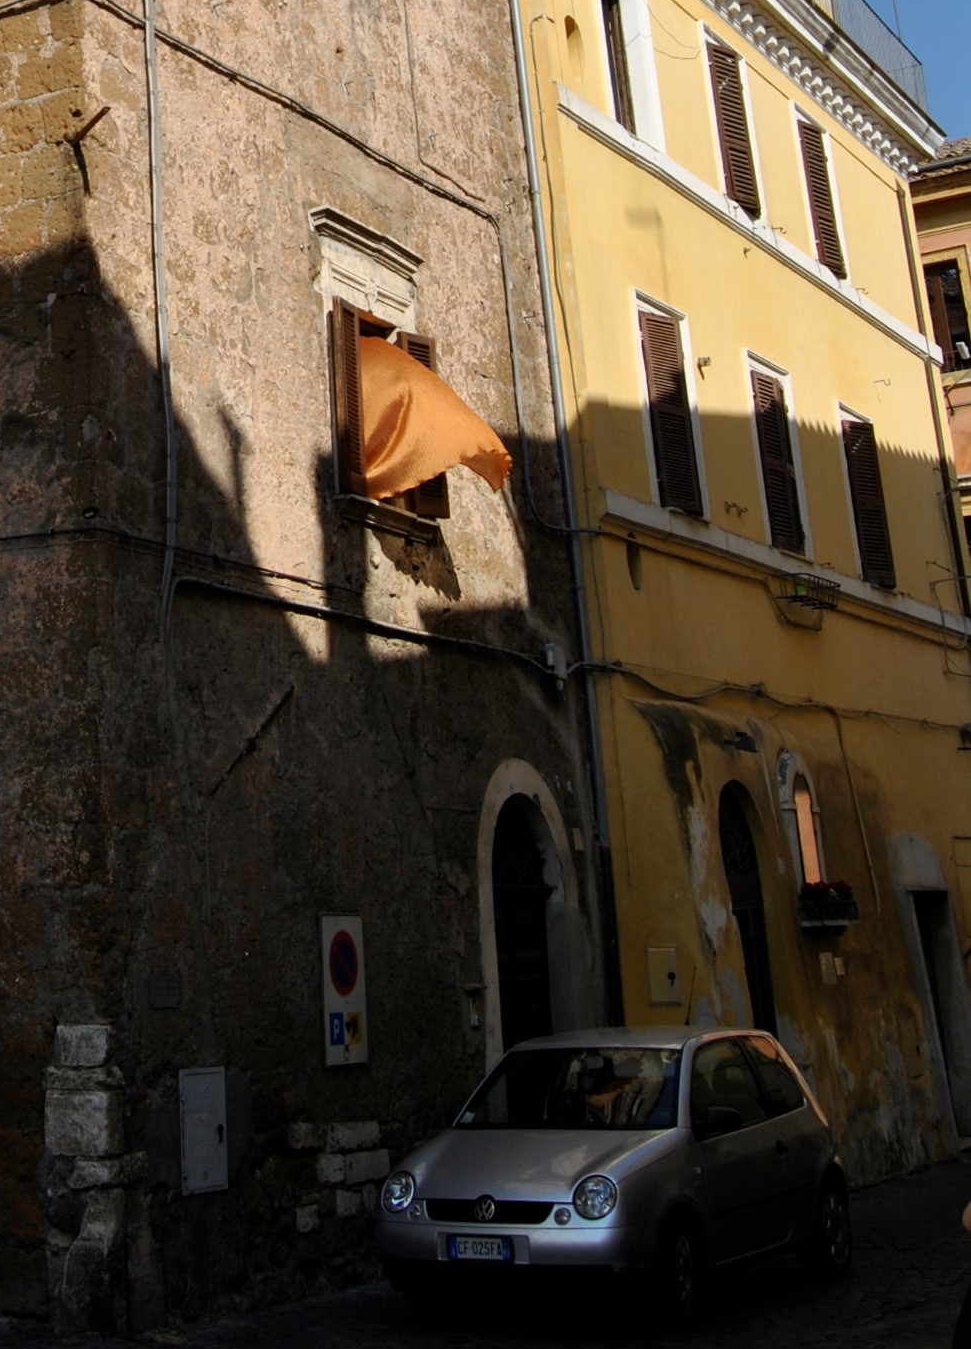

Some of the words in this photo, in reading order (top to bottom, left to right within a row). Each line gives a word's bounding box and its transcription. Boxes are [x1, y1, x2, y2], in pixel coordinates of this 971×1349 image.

[333, 1019, 340, 1039] P
[457, 1241, 469, 1256] CF
[472, 1241, 502, 1256] 025FA
